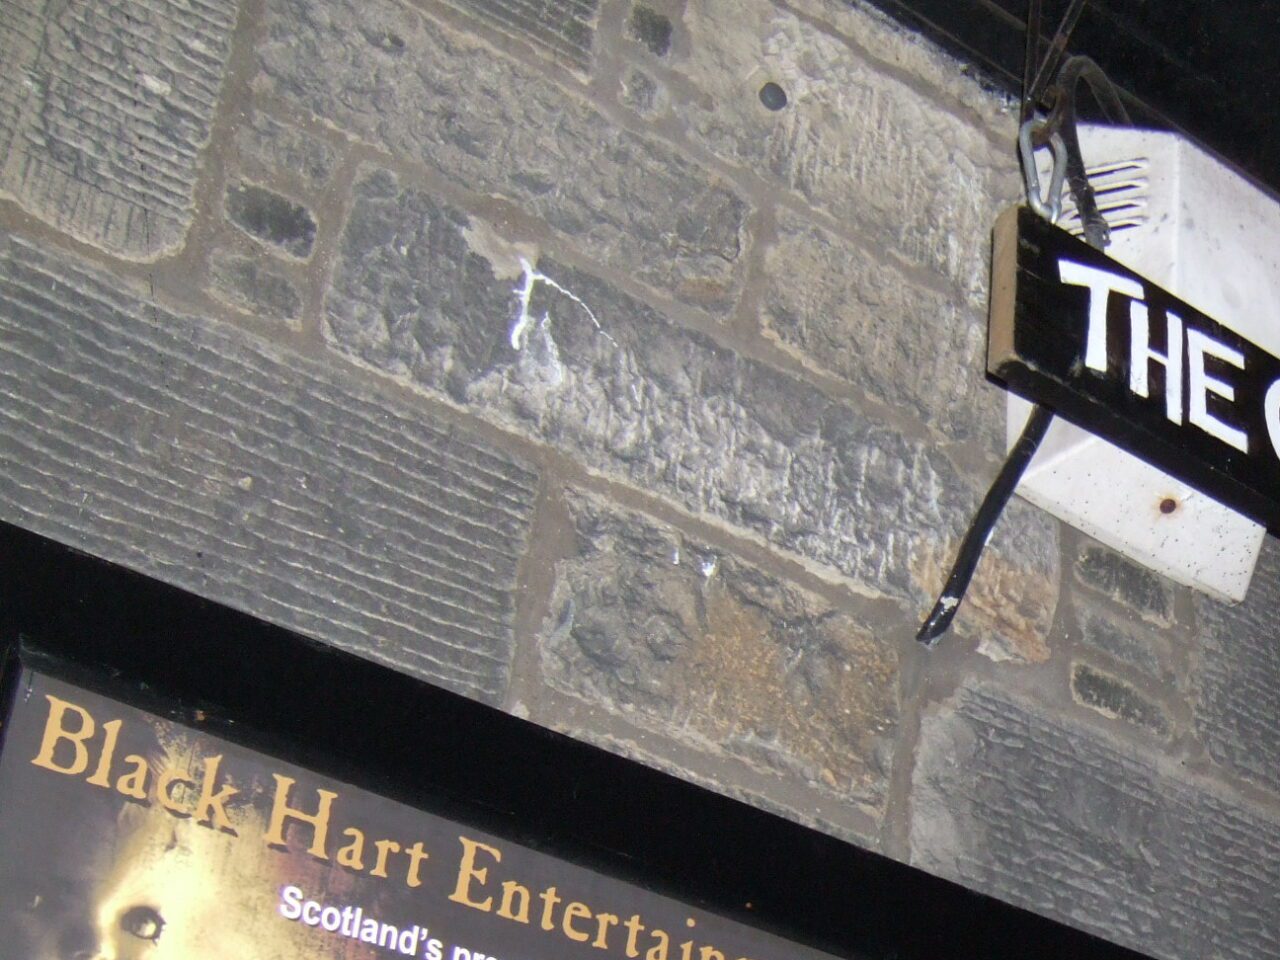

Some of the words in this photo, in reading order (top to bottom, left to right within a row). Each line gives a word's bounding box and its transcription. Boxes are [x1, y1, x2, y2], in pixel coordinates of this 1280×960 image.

[1057, 259, 1249, 454] THE
[33, 695, 238, 833] Black
[267, 775, 428, 888] Hart
